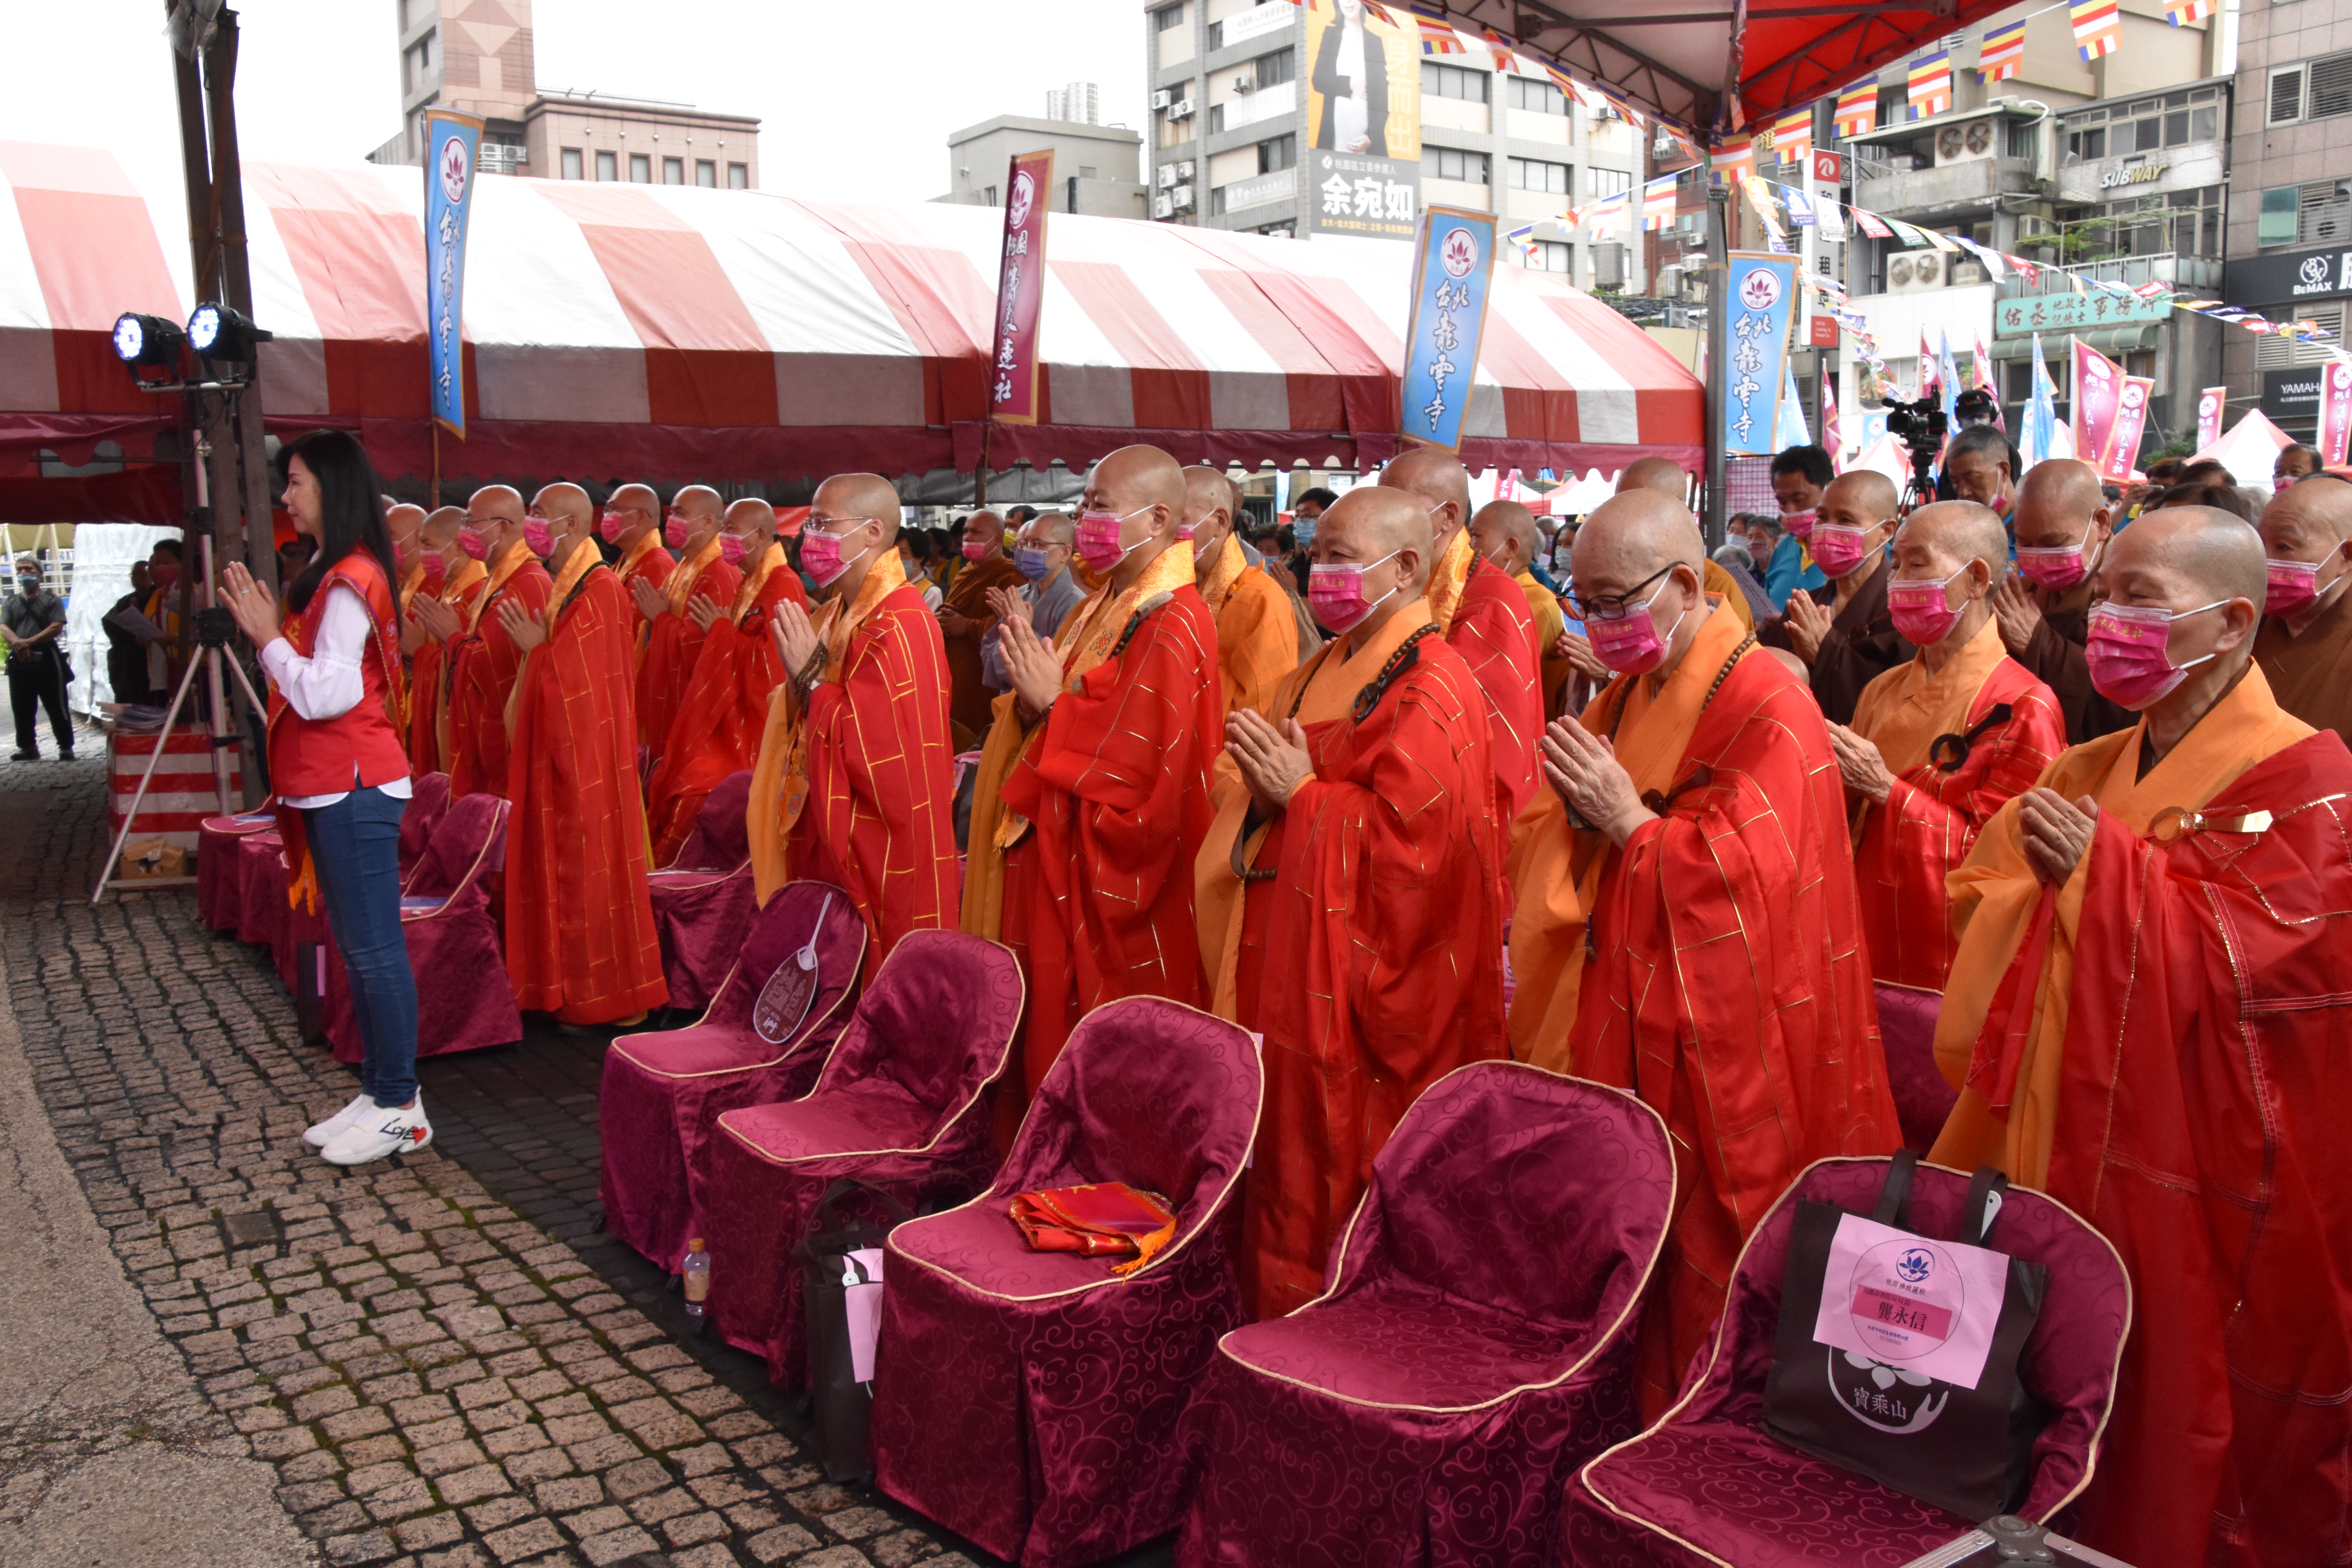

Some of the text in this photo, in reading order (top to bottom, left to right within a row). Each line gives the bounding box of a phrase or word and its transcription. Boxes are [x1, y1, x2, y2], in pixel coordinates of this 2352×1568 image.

[2099, 163, 2168, 189] SUBWAY
[1321, 172, 1414, 221] 余宛如
[2281, 382, 2321, 394] YAMAH
[1878, 1301, 1927, 1331] 龔永信
[1853, 1386, 1908, 1421] 寶乘山
